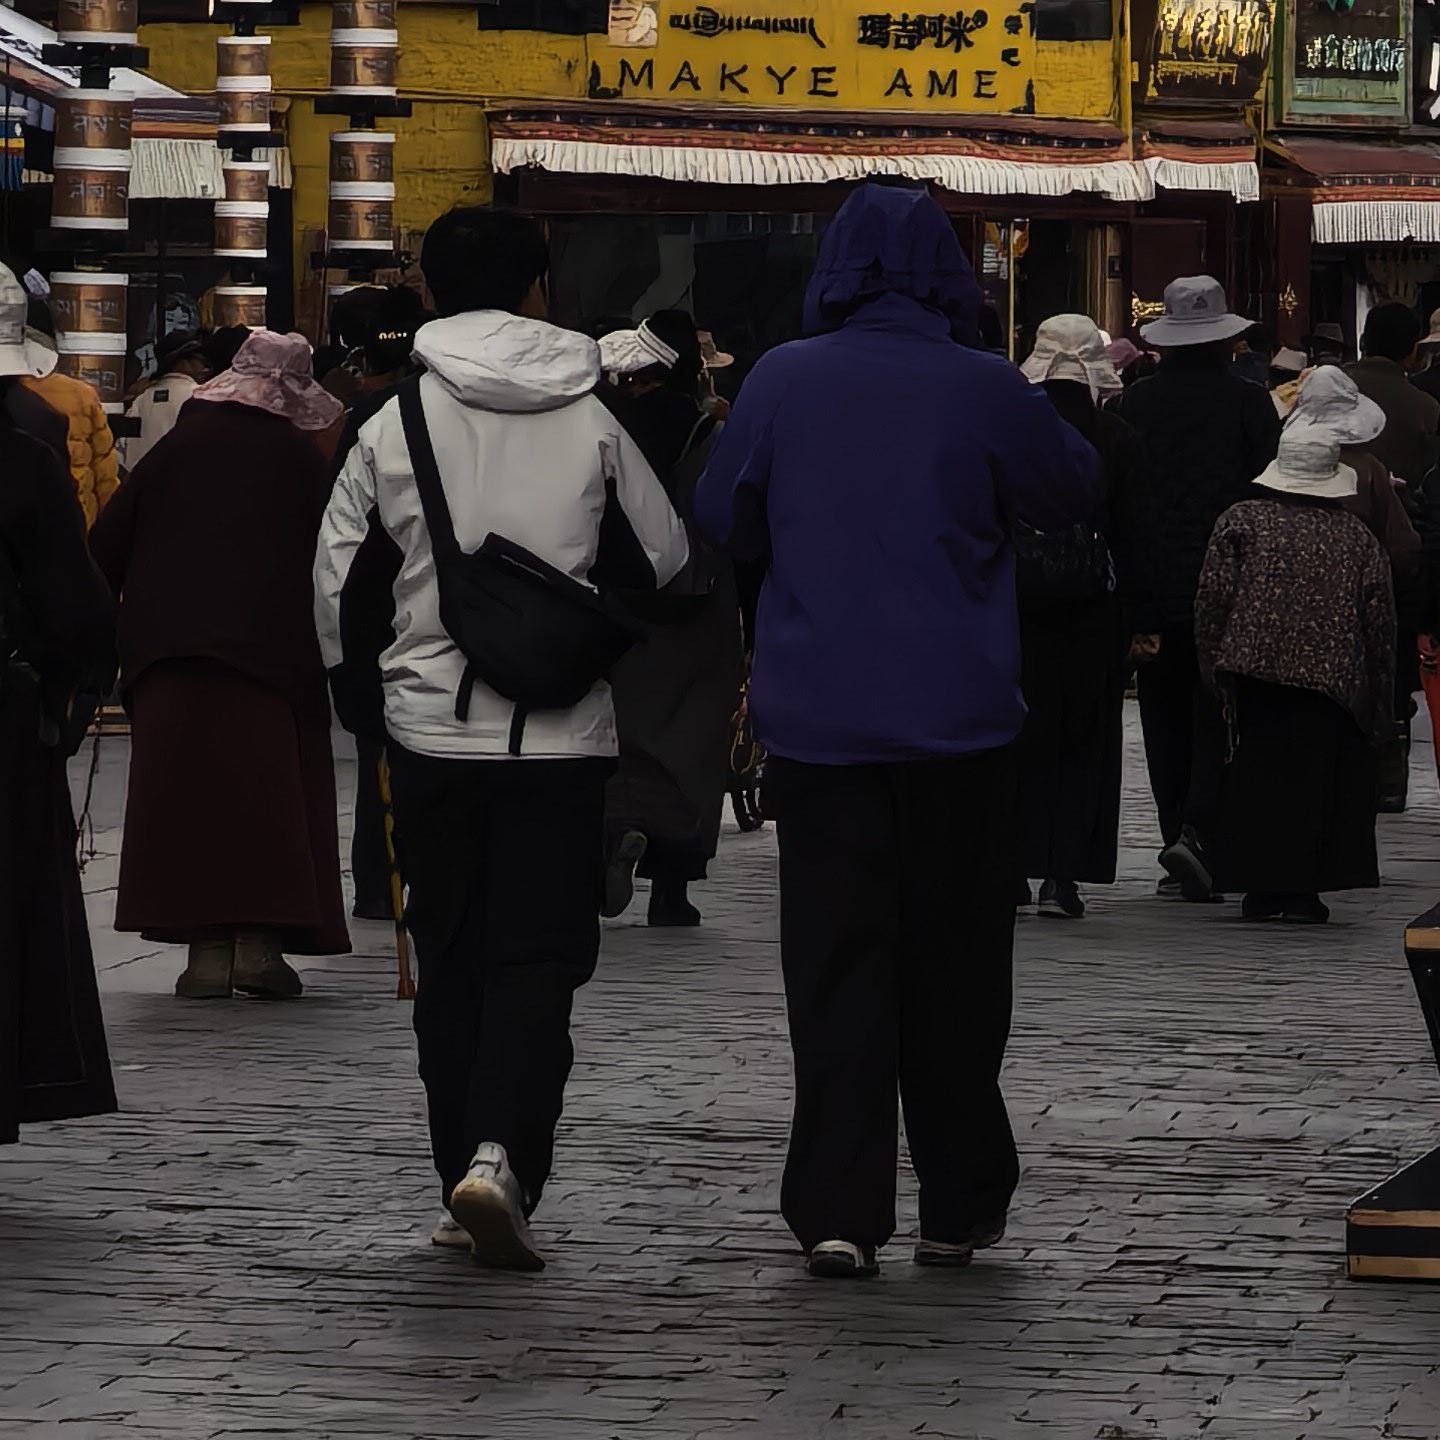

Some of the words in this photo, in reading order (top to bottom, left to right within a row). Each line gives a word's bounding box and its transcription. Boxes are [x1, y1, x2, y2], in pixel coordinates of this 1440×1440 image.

[857, 10, 975, 53] 玛吉阿米
[618, 59, 839, 98] MAKYE
[884, 67, 998, 98] AME
